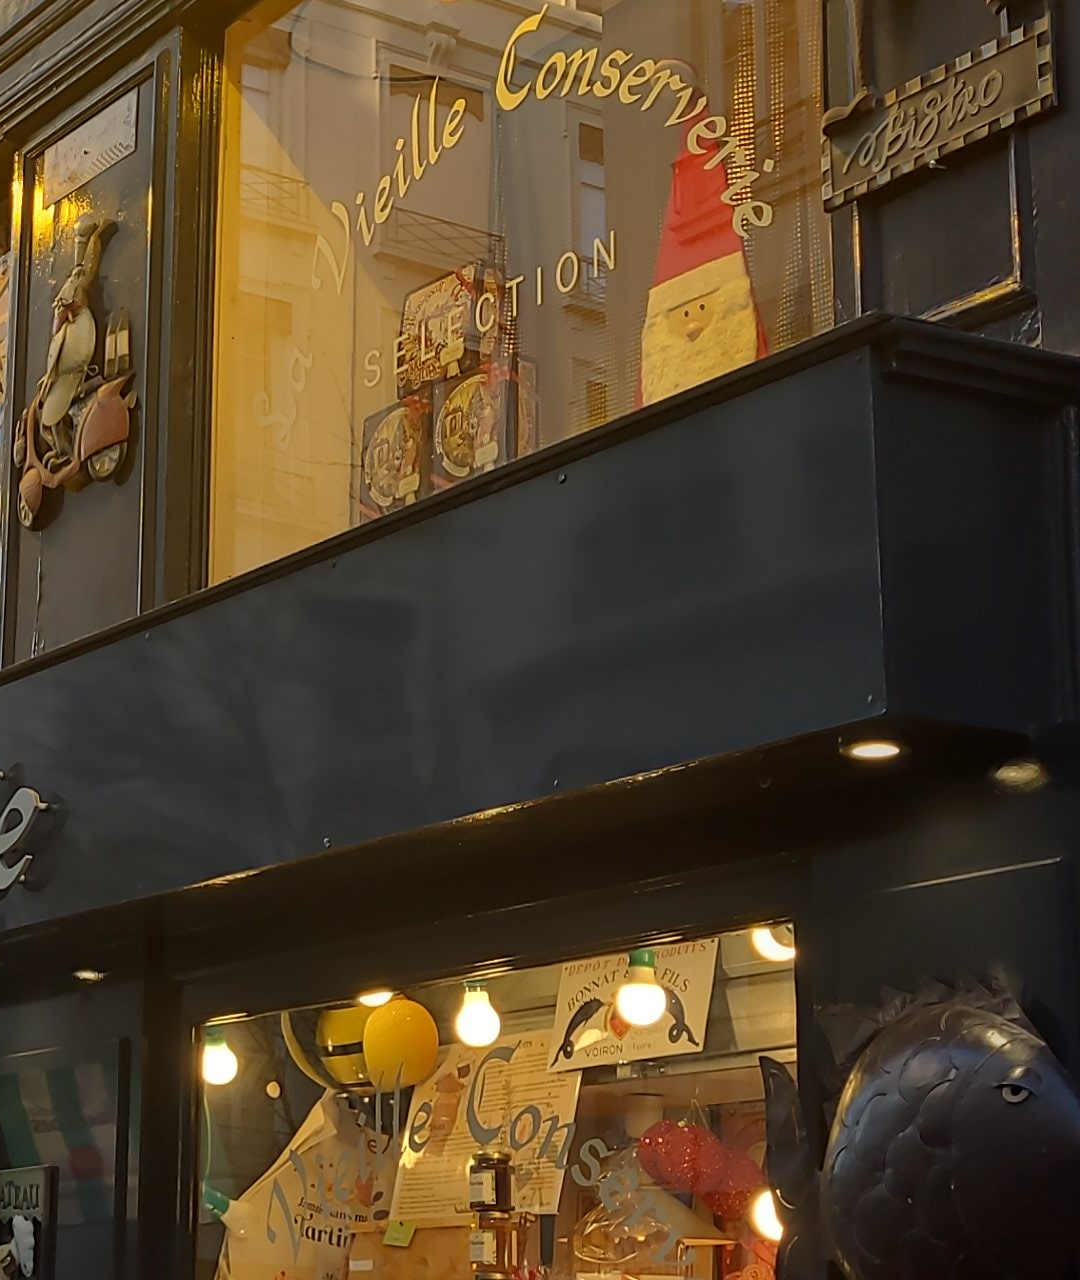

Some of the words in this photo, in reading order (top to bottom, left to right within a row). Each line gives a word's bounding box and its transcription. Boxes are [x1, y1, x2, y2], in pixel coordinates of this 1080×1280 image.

[313, 75, 466, 297] Vieille
[495, 4, 772, 237] Conserverie
[364, 230, 616, 387] SELECTION
[567, 970, 620, 1012] BONNAT
[661, 968, 690, 993] FILS
[655, 942, 707, 960] RODUITS
[585, 1044, 623, 1058] VOIRON
[267, 1062, 434, 1264] Vieille
